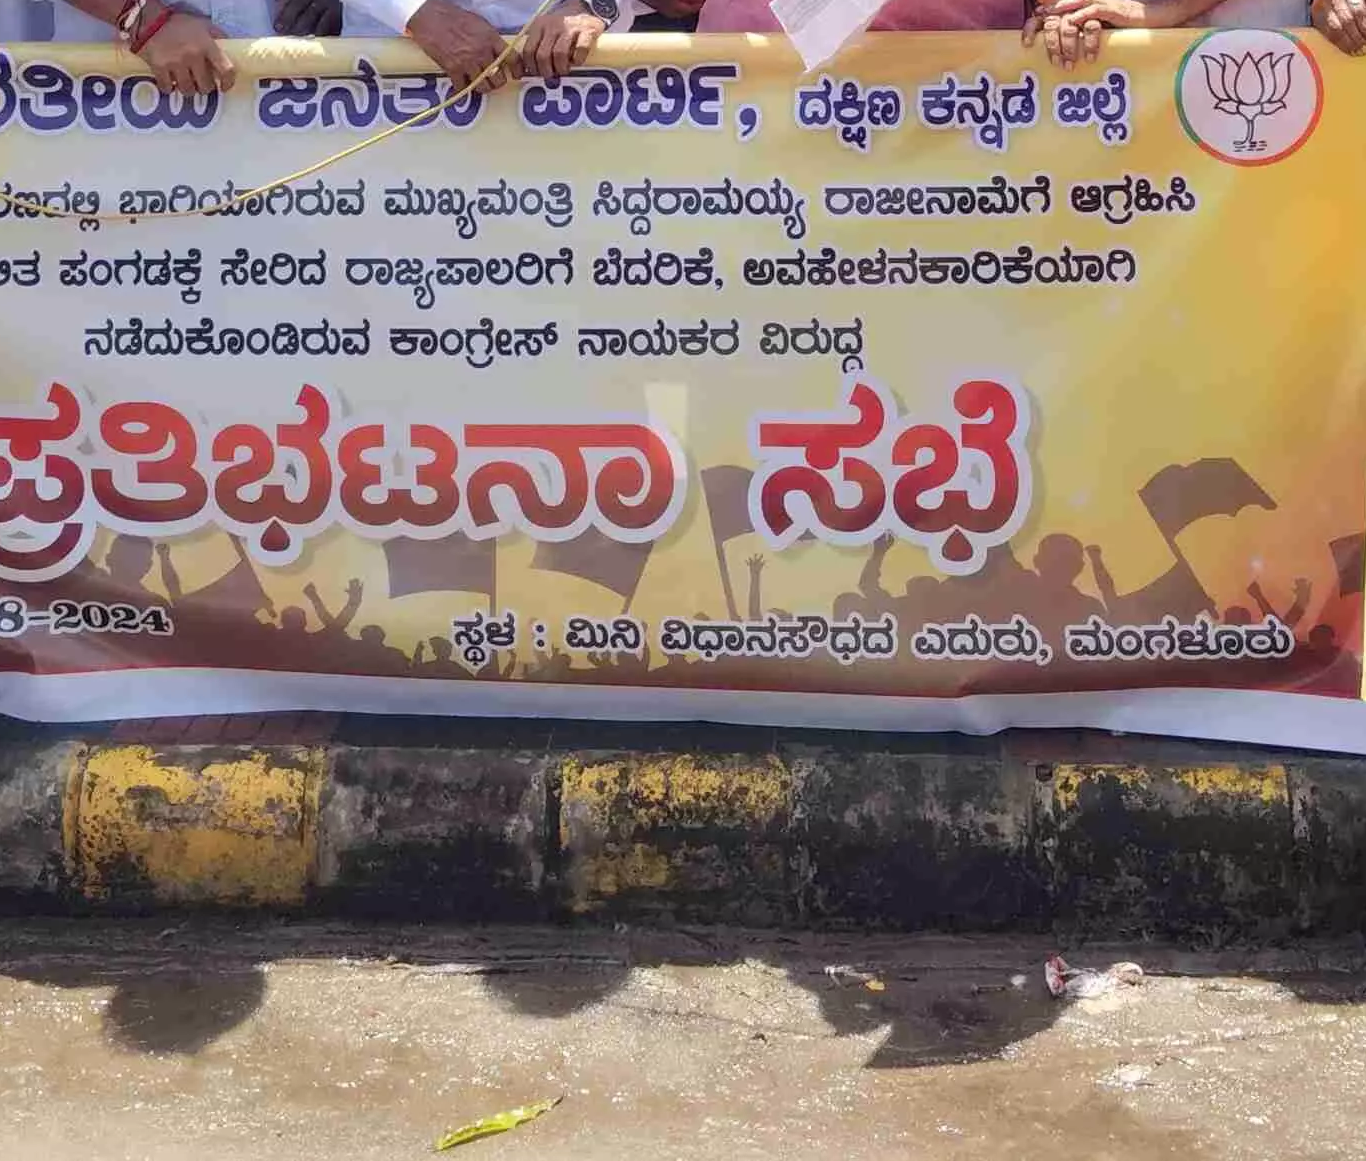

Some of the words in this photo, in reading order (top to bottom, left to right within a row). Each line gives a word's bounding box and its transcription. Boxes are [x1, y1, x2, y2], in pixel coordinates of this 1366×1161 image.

[257, 58, 483, 129] ಜನತಾ
[797, 74, 902, 150] ದಕ್ಷಿಣ
[921, 74, 1036, 150] ಕನ್ನಡ
[1055, 70, 1132, 144] ಜಿಲ್ಲೆ
[119, 178, 366, 225] ಭಾಗಿಯಾಗಿರುವ
[383, 178, 574, 240] ಮುಖ್ಯಮಂತ್ರಿ
[591, 177, 807, 240] ಸಿದ್ದರಾಮಯ್ಯ
[825, 174, 1051, 219] ರಾಜೀನಾಮೆಗೆ
[1071, 173, 1196, 224] ಆಗ್ರಹಿಸಿ
[58, 247, 204, 305] ಪಂಗಡಕ್ಕೆ
[221, 248, 327, 288] ಸೇರಿದ
[345, 246, 574, 309] ರಾಜ್ಯಪಾಲರಿಗೆ
[592, 246, 725, 291] ಬೆದರಿಕೆ,
[742, 245, 1138, 288] ಅವಹೇಳನಕಾರಿಕೆಯಾಗಿ
[83, 317, 371, 357] ನಡೆದುಕೊಂಡಿರುವ
[578, 317, 740, 357] ನಾಯಕರ
[757, 379, 1021, 562] ಸಭೆ
[453, 612, 516, 666] ಸ್ಥಳ
[565, 616, 641, 649] ಮಿನಿ
[662, 613, 894, 661] ವಿಧಾನಸೌಧದ
[915, 614, 1049, 661] ಎದುರು,
[1070, 615, 1291, 658] ಮಂಗಳೂರು
